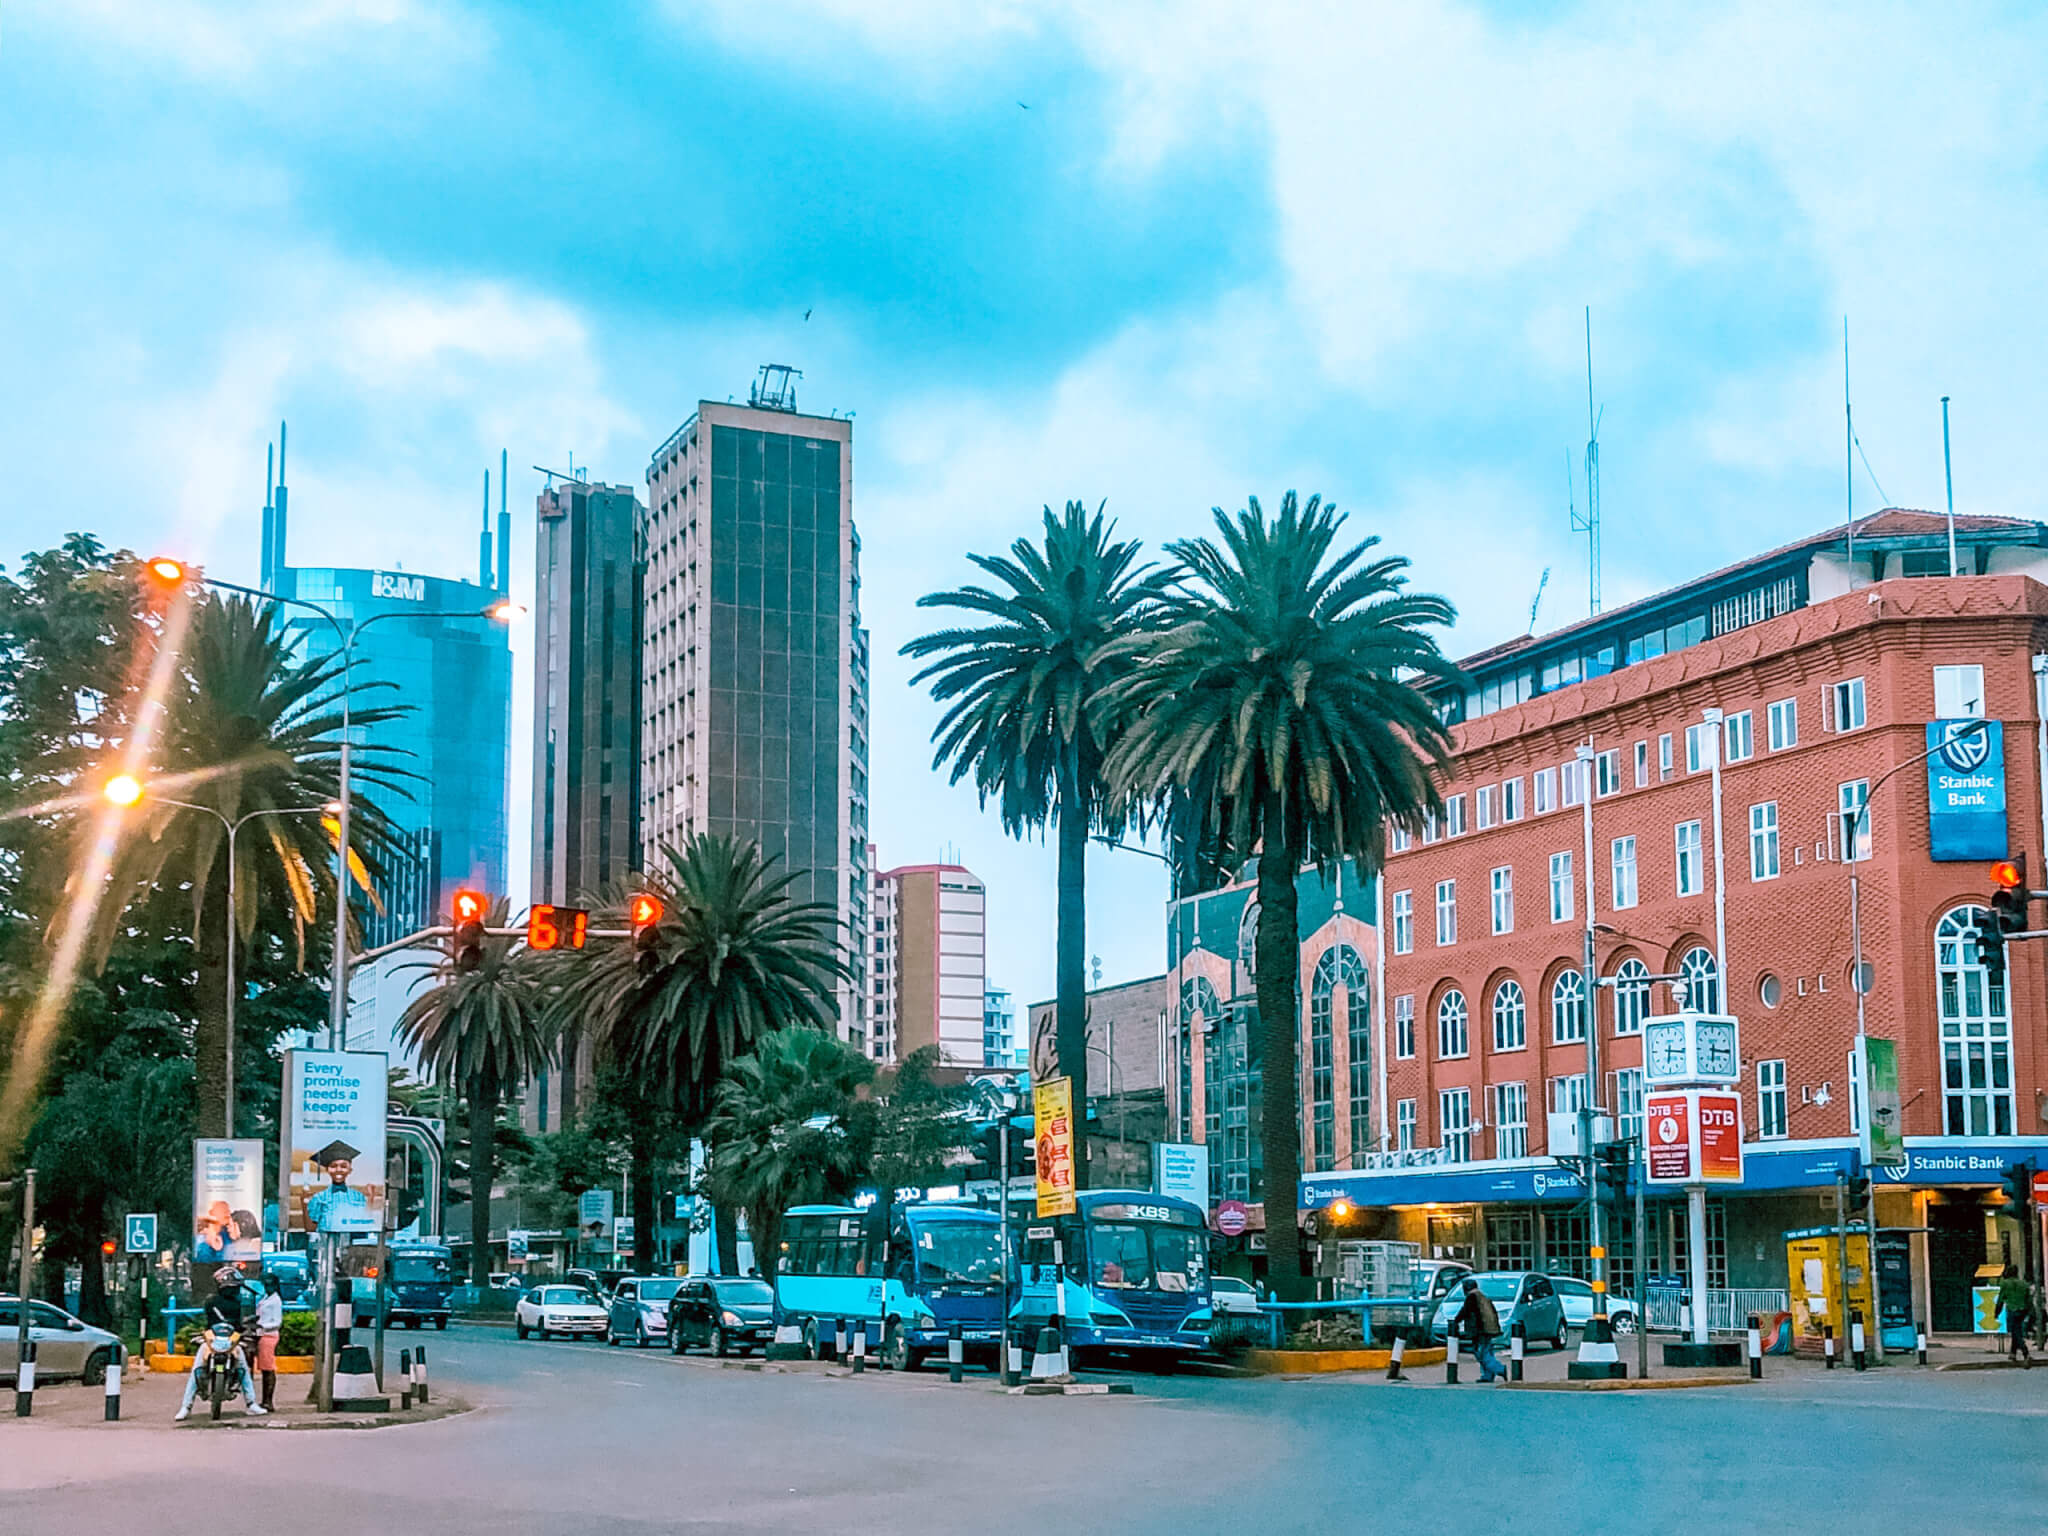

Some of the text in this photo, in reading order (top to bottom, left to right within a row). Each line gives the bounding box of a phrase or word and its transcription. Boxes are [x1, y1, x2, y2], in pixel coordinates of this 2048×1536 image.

[372, 573, 425, 601] I&M
[1938, 774, 1995, 790] Stanbic
[1947, 791, 1986, 806] Bank
[528, 904, 587, 950] 61
[304, 1061, 343, 1077] Every
[303, 1075, 361, 1089] promise
[303, 1088, 358, 1100] needs a
[303, 1100, 352, 1115] keeper
[1649, 1105, 1671, 1117] DTB
[1701, 1109, 1735, 1126] DTB
[1913, 1155, 2004, 1170] Stanbic Bank
[1135, 1205, 1170, 1219] KBS
